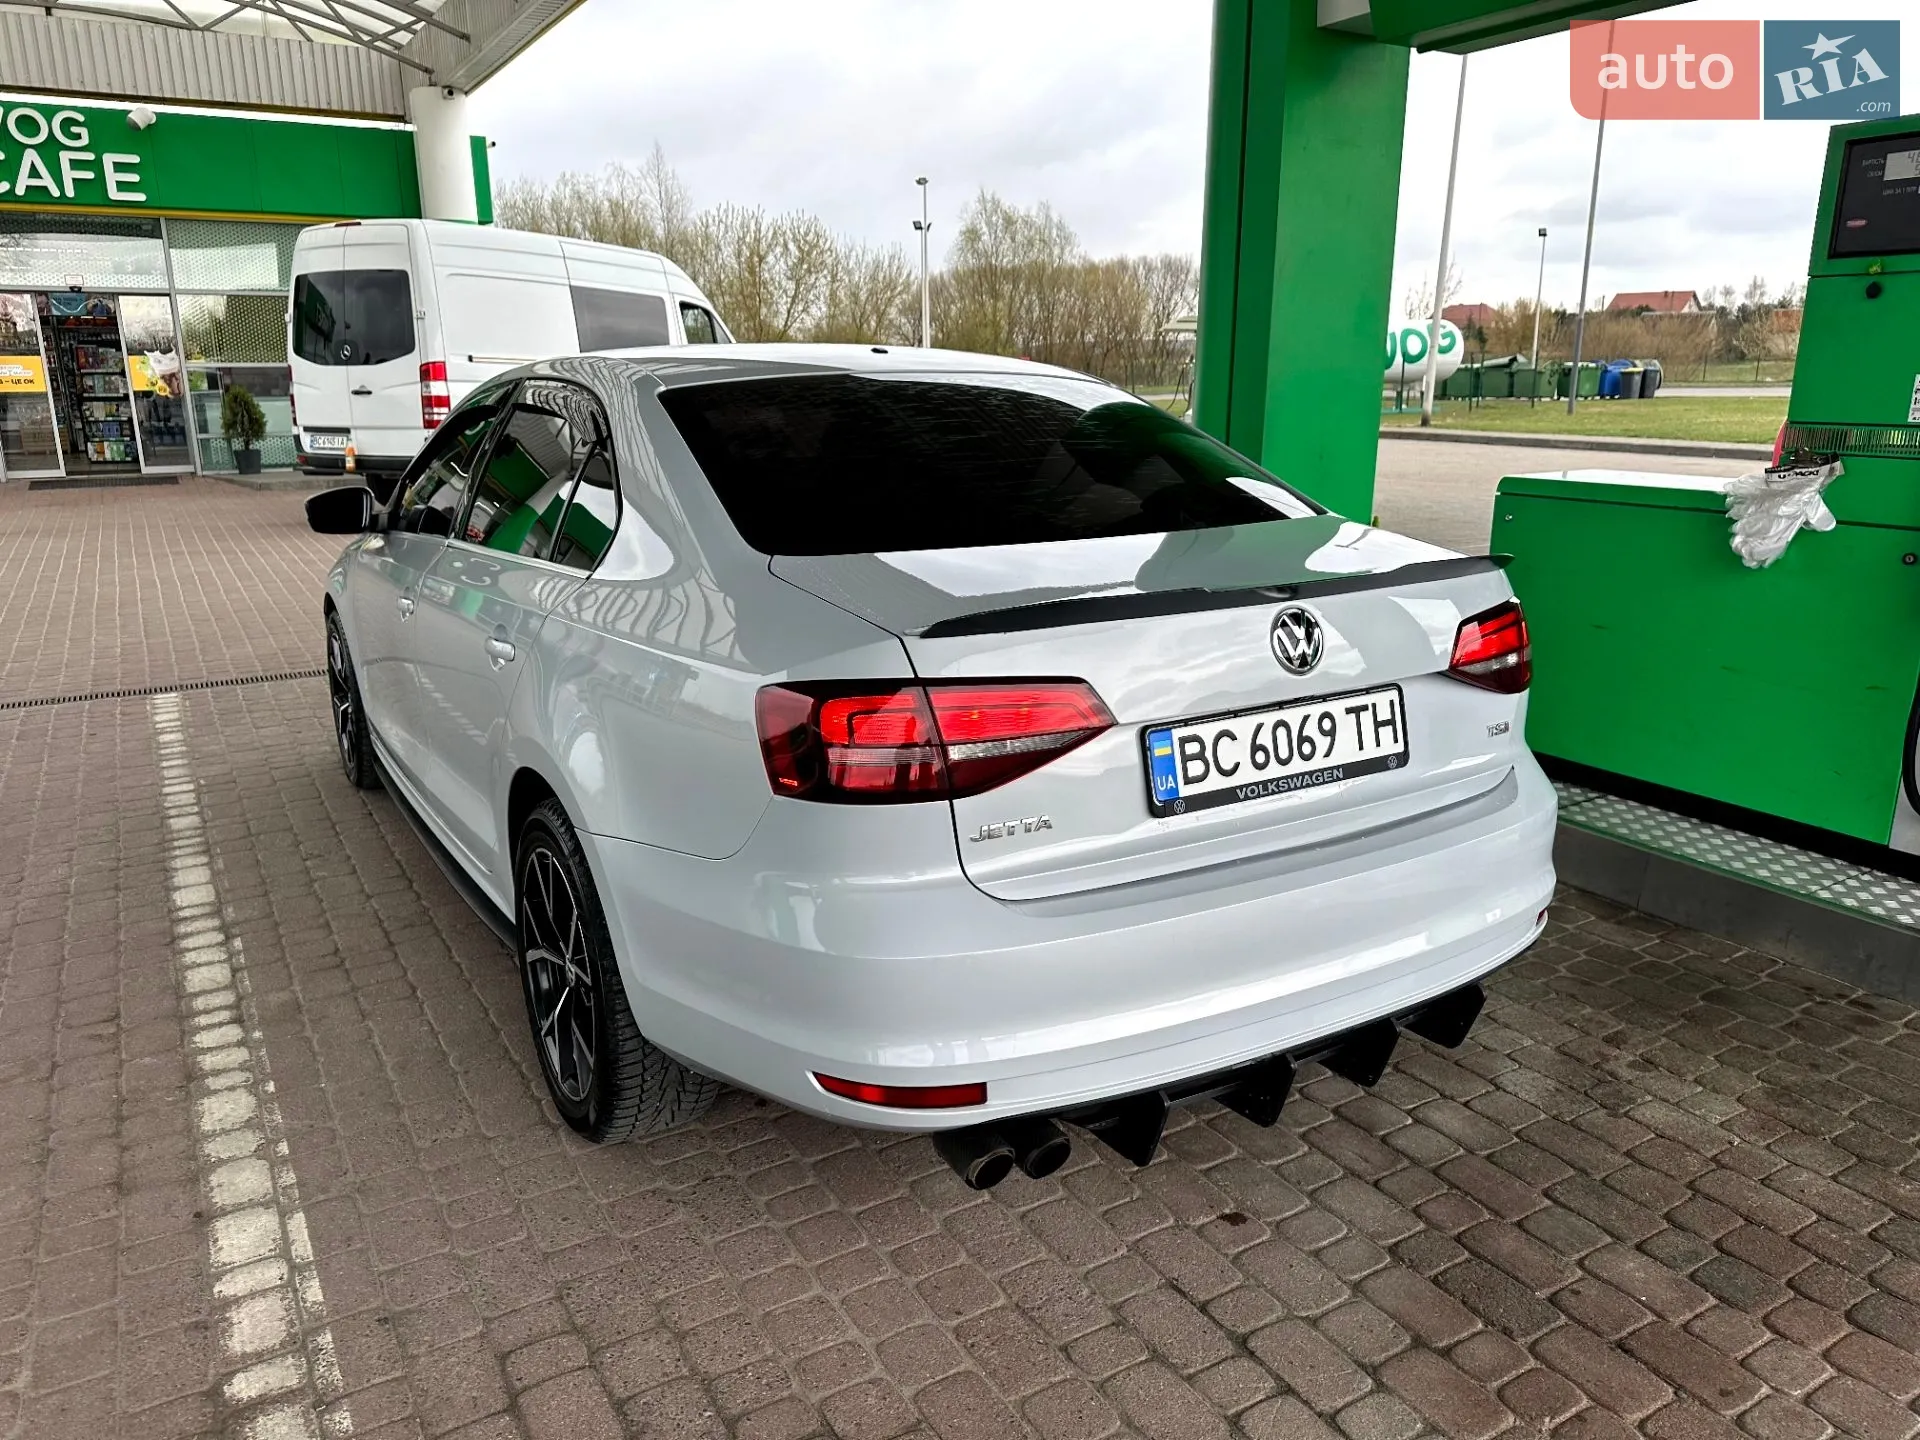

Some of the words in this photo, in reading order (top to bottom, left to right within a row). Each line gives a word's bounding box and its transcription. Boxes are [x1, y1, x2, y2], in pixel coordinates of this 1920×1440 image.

[0, 106, 90, 148] OG
[0, 148, 147, 201] AFE
[1177, 728, 1240, 786] BC
[1249, 710, 1337, 771] 6069
[1344, 699, 1399, 751] TH
[1157, 775, 1176, 791] UA
[1236, 767, 1344, 800] VOLKSWAGEN
[968, 814, 1053, 842] JETTA
